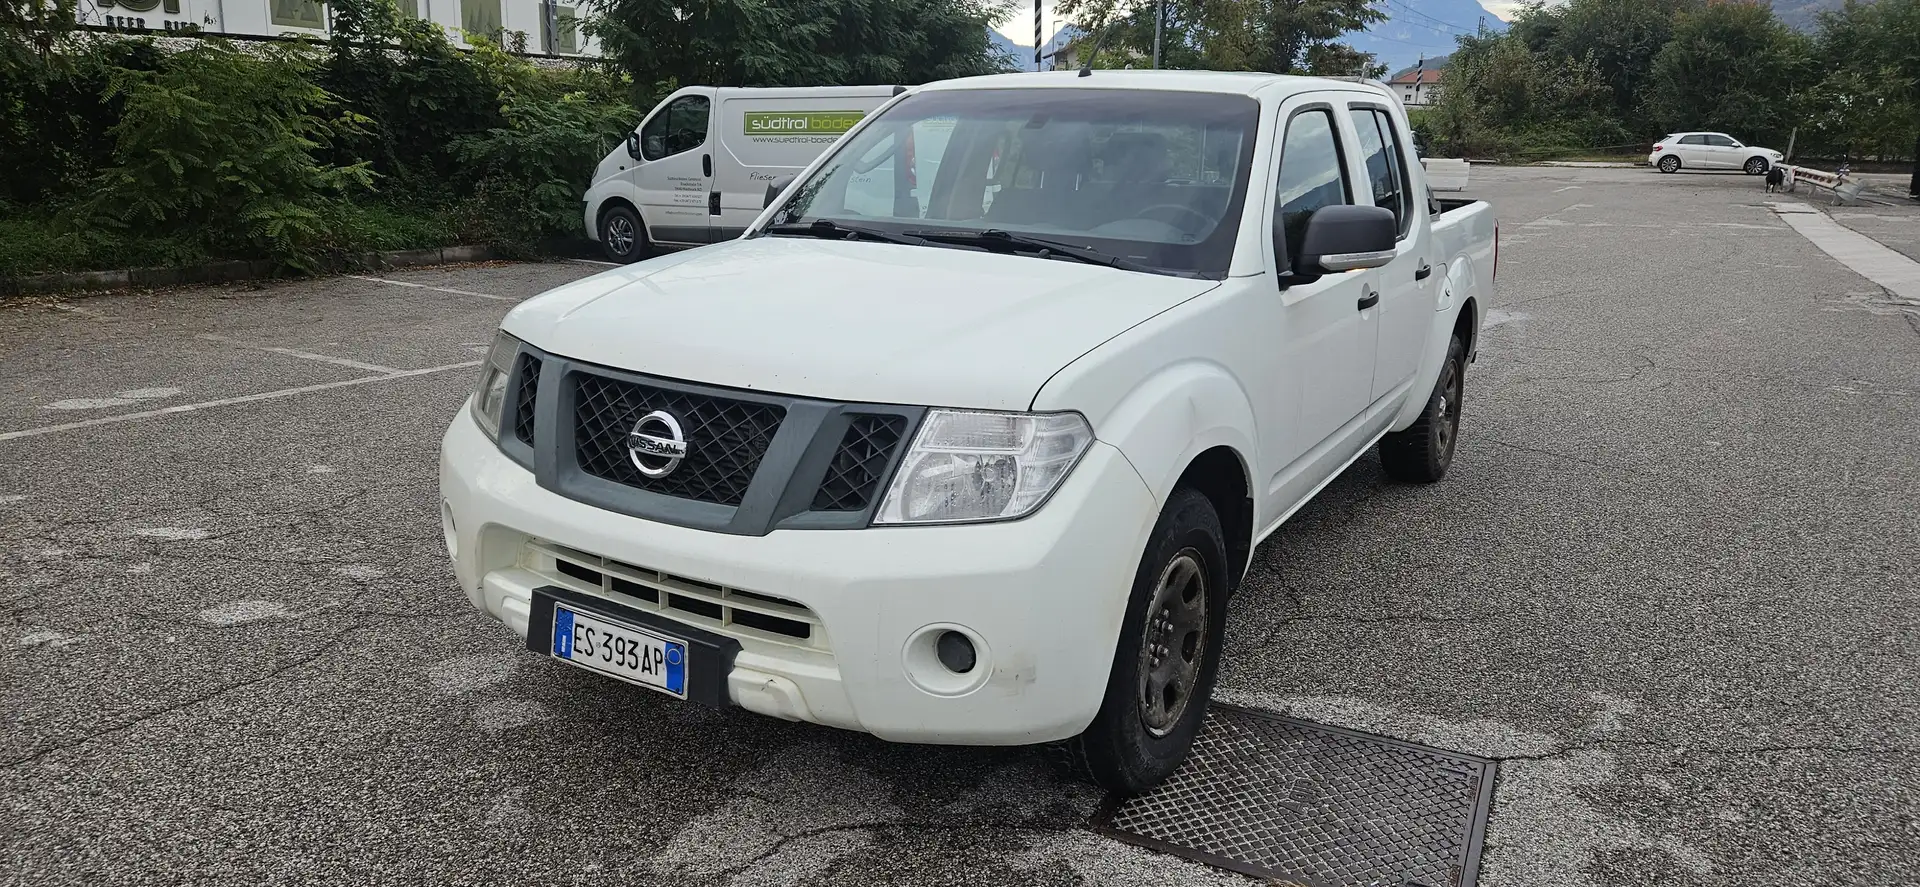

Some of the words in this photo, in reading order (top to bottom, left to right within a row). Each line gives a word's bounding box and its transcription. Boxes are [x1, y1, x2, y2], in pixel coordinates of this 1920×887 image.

[106, 15, 146, 29] BEER
[751, 116, 808, 130] südtirol
[630, 436, 677, 455] NISSAN
[573, 623, 596, 657] ES
[602, 632, 664, 676] 393AP
